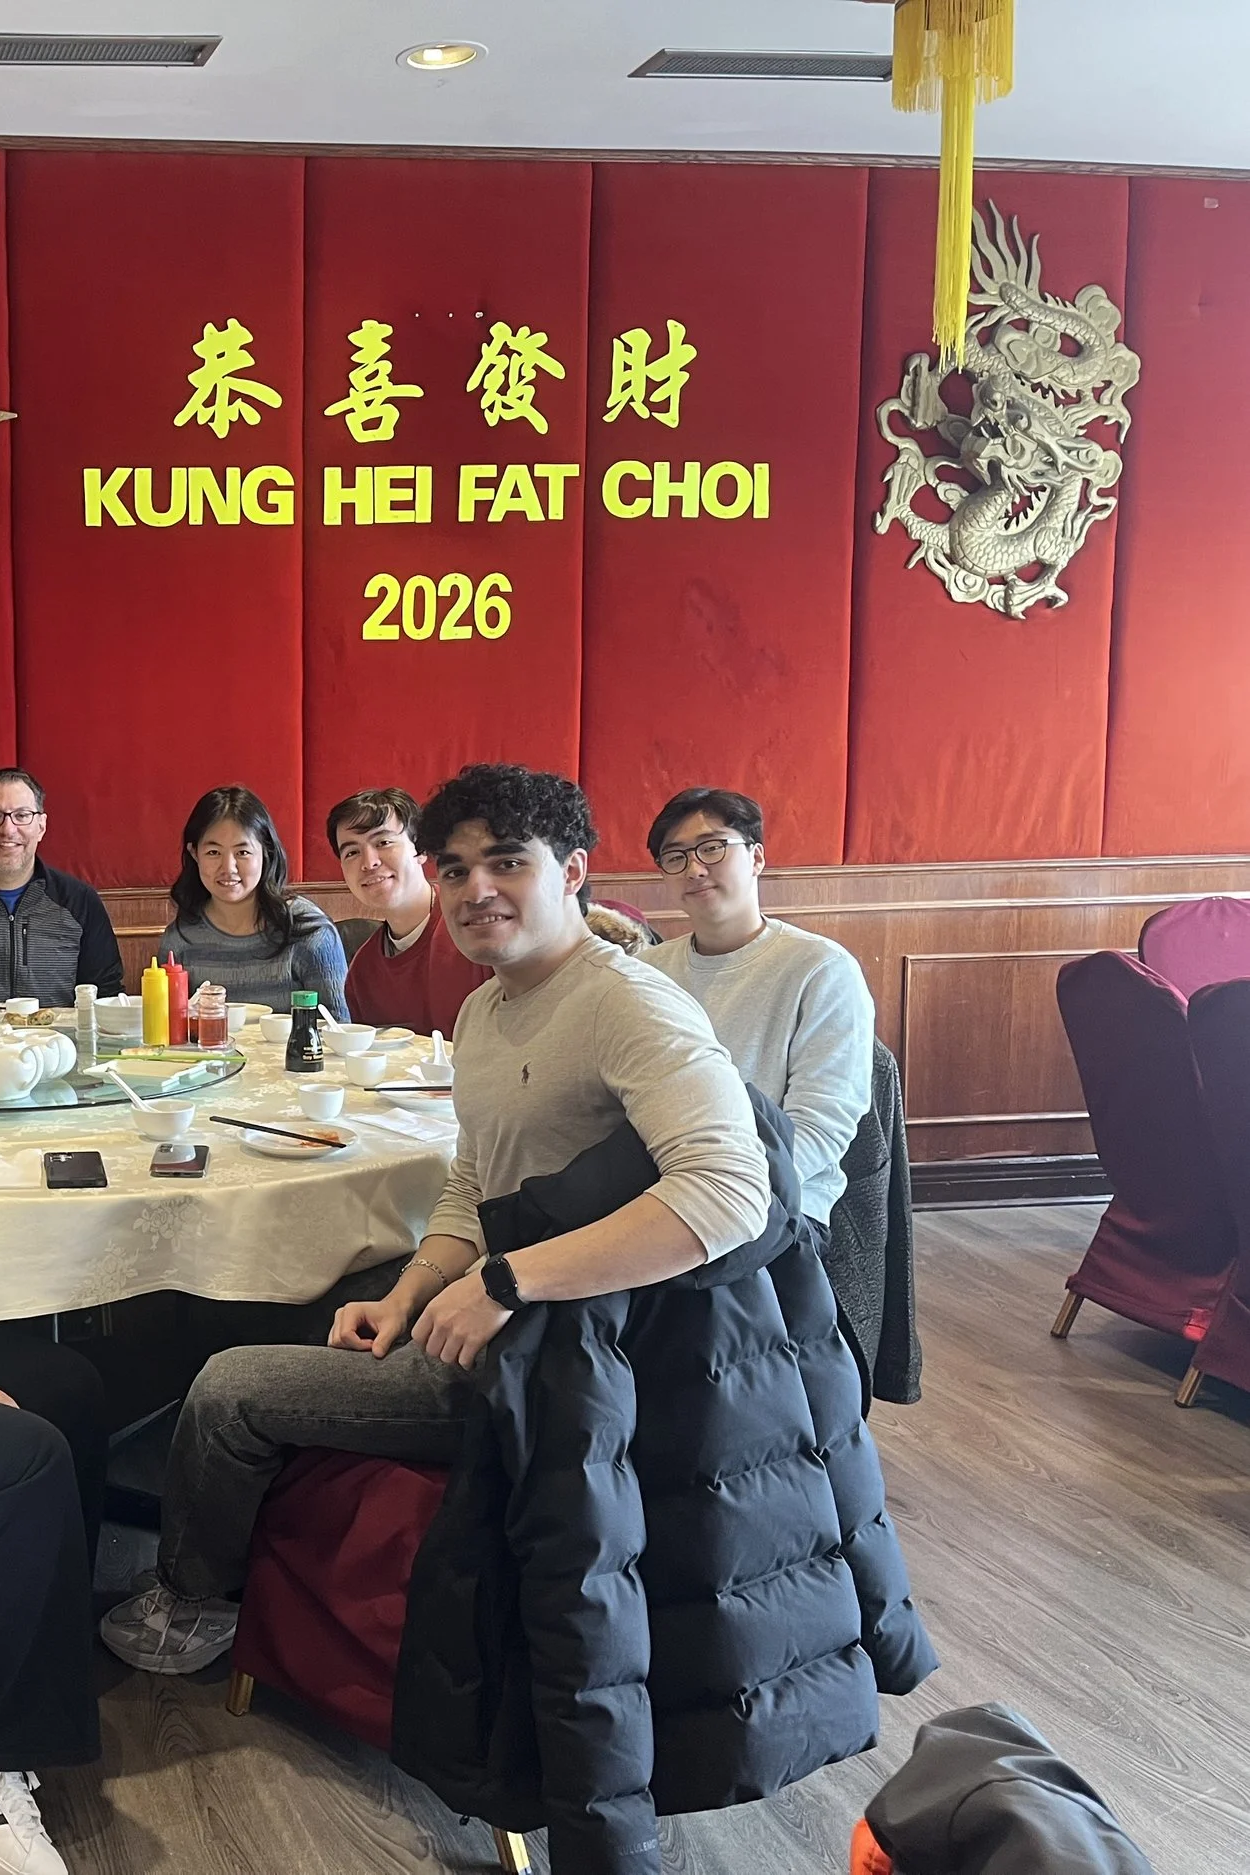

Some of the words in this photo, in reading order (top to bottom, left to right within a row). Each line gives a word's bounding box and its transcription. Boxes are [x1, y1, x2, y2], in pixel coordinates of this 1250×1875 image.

[173, 318, 697, 443] 恭喜發財
[83, 465, 295, 527] KUNG
[323, 465, 433, 526] HEI
[458, 464, 580, 522] FAT
[602, 460, 770, 519] CHOI
[362, 573, 513, 641] 2026
